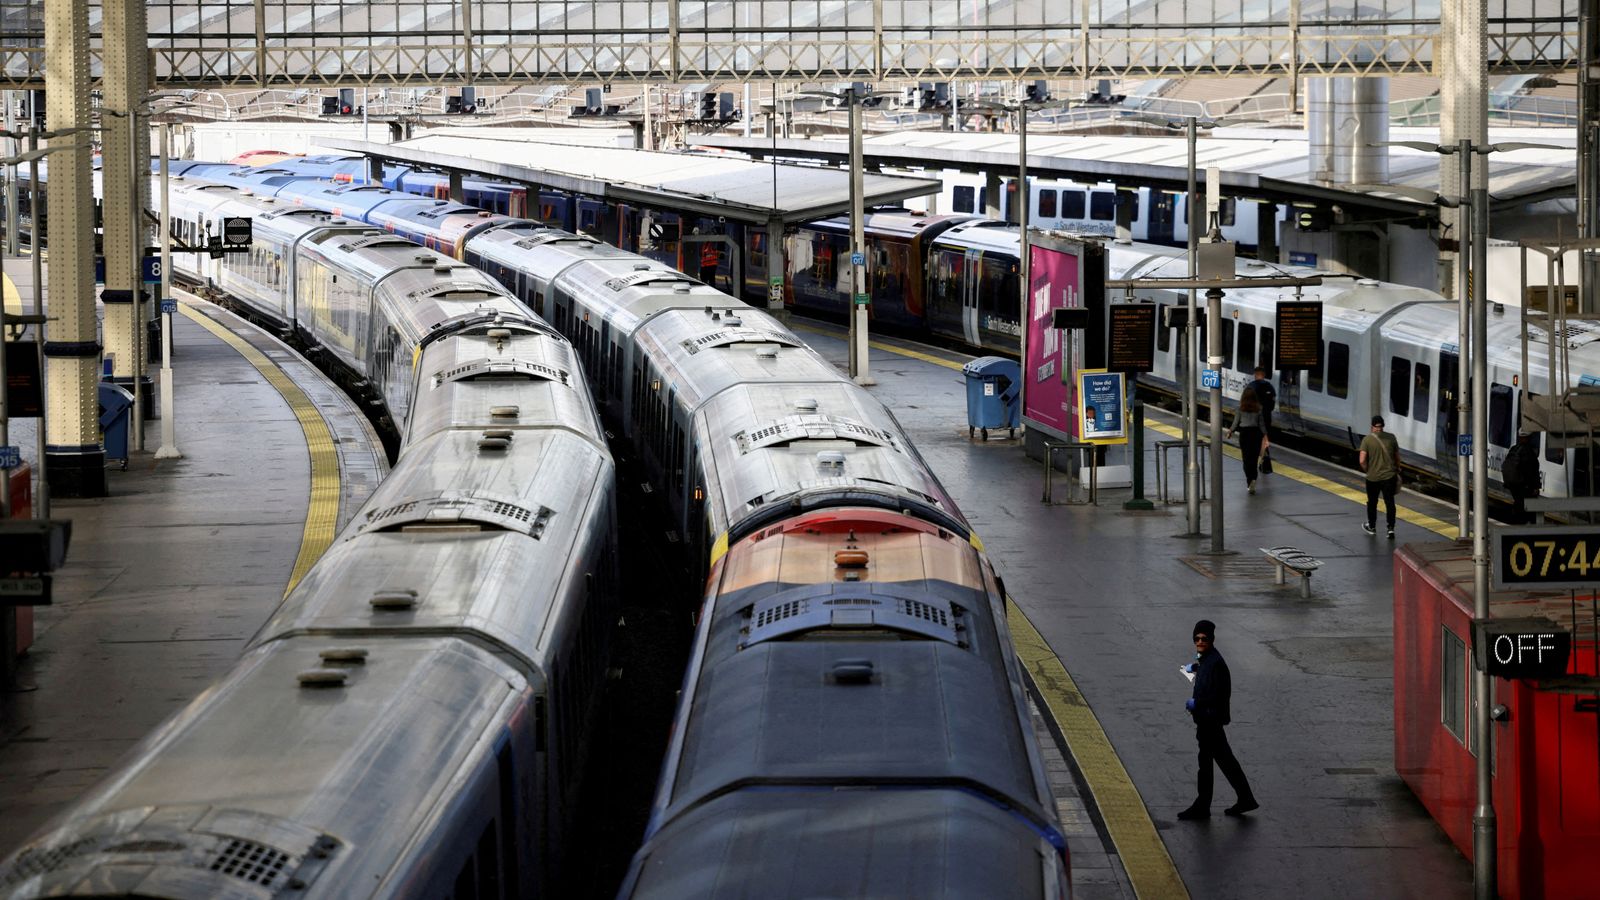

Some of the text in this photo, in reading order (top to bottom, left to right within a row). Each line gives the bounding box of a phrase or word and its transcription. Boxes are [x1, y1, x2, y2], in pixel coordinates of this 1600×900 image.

[853, 257, 864, 265] 017
[151, 262, 161, 276] 8
[163, 304, 176, 313] 015
[1203, 377, 1217, 387] 017
[1460, 443, 1471, 455] 01
[1494, 634, 1555, 664] OFF
